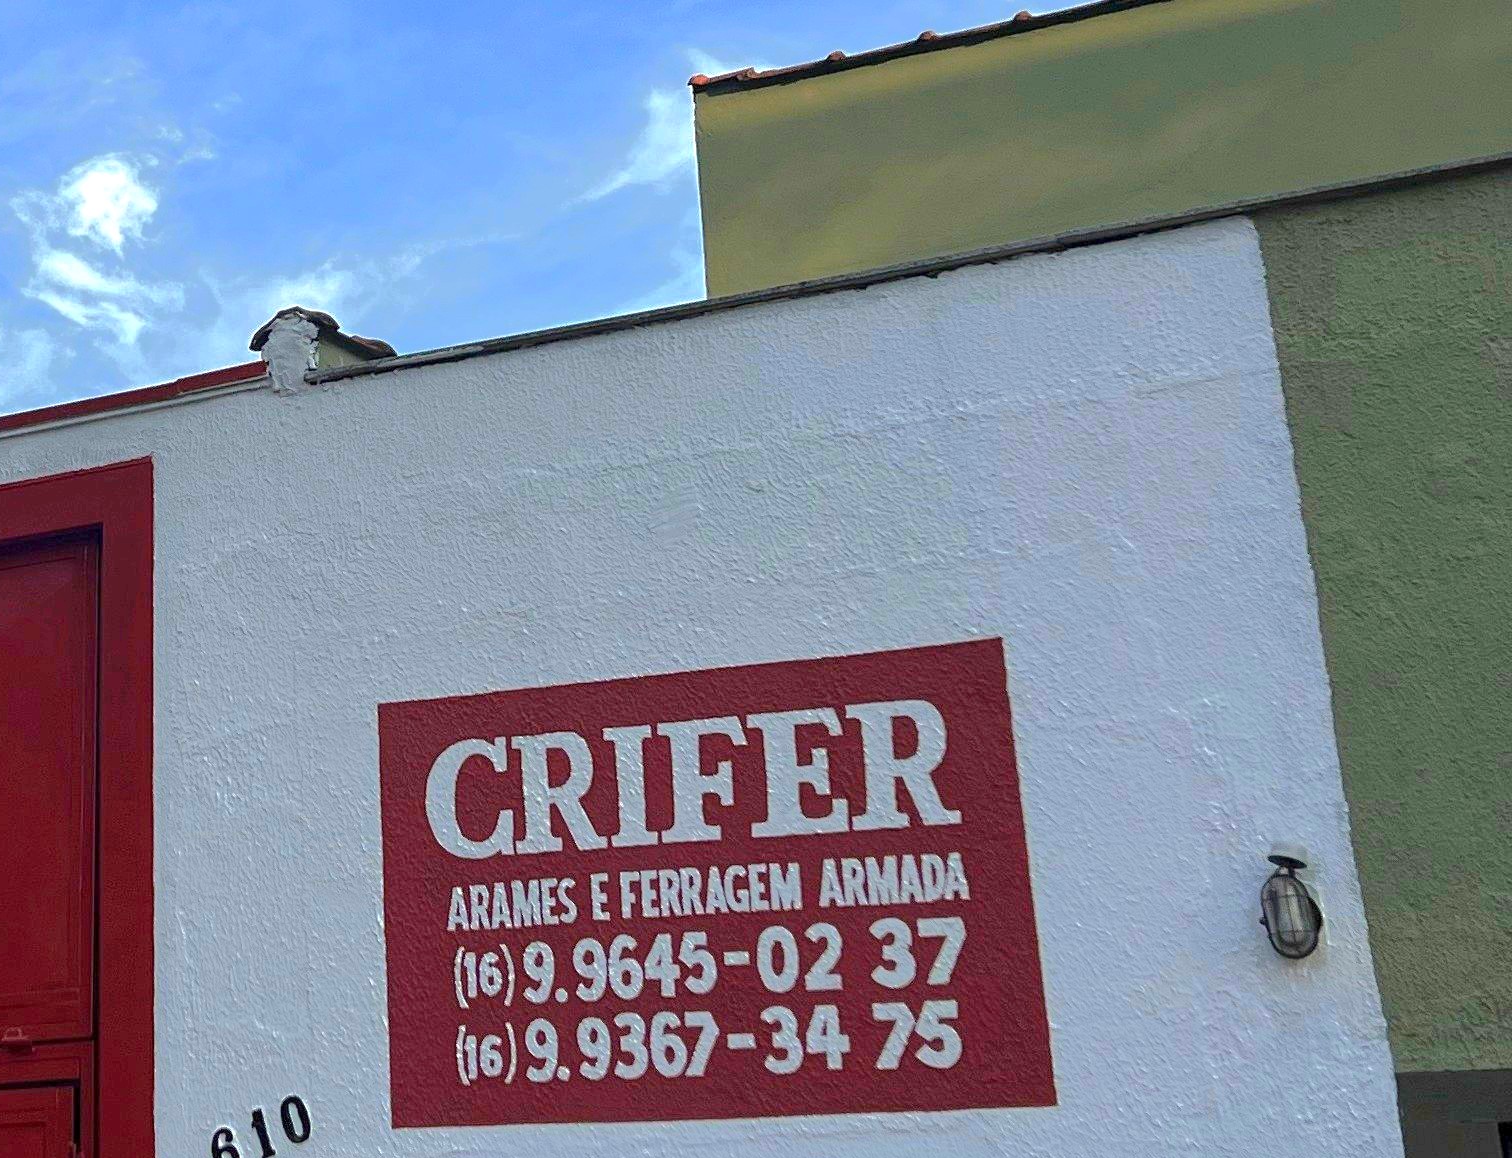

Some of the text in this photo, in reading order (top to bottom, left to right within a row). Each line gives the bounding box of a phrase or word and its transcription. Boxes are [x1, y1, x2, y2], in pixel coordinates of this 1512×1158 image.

[424, 699, 963, 860] CRIFER
[446, 851, 971, 933] ARAMES E FERRAGEM ARMADA
[868, 916, 968, 990] 37
[871, 998, 963, 1071] 75
